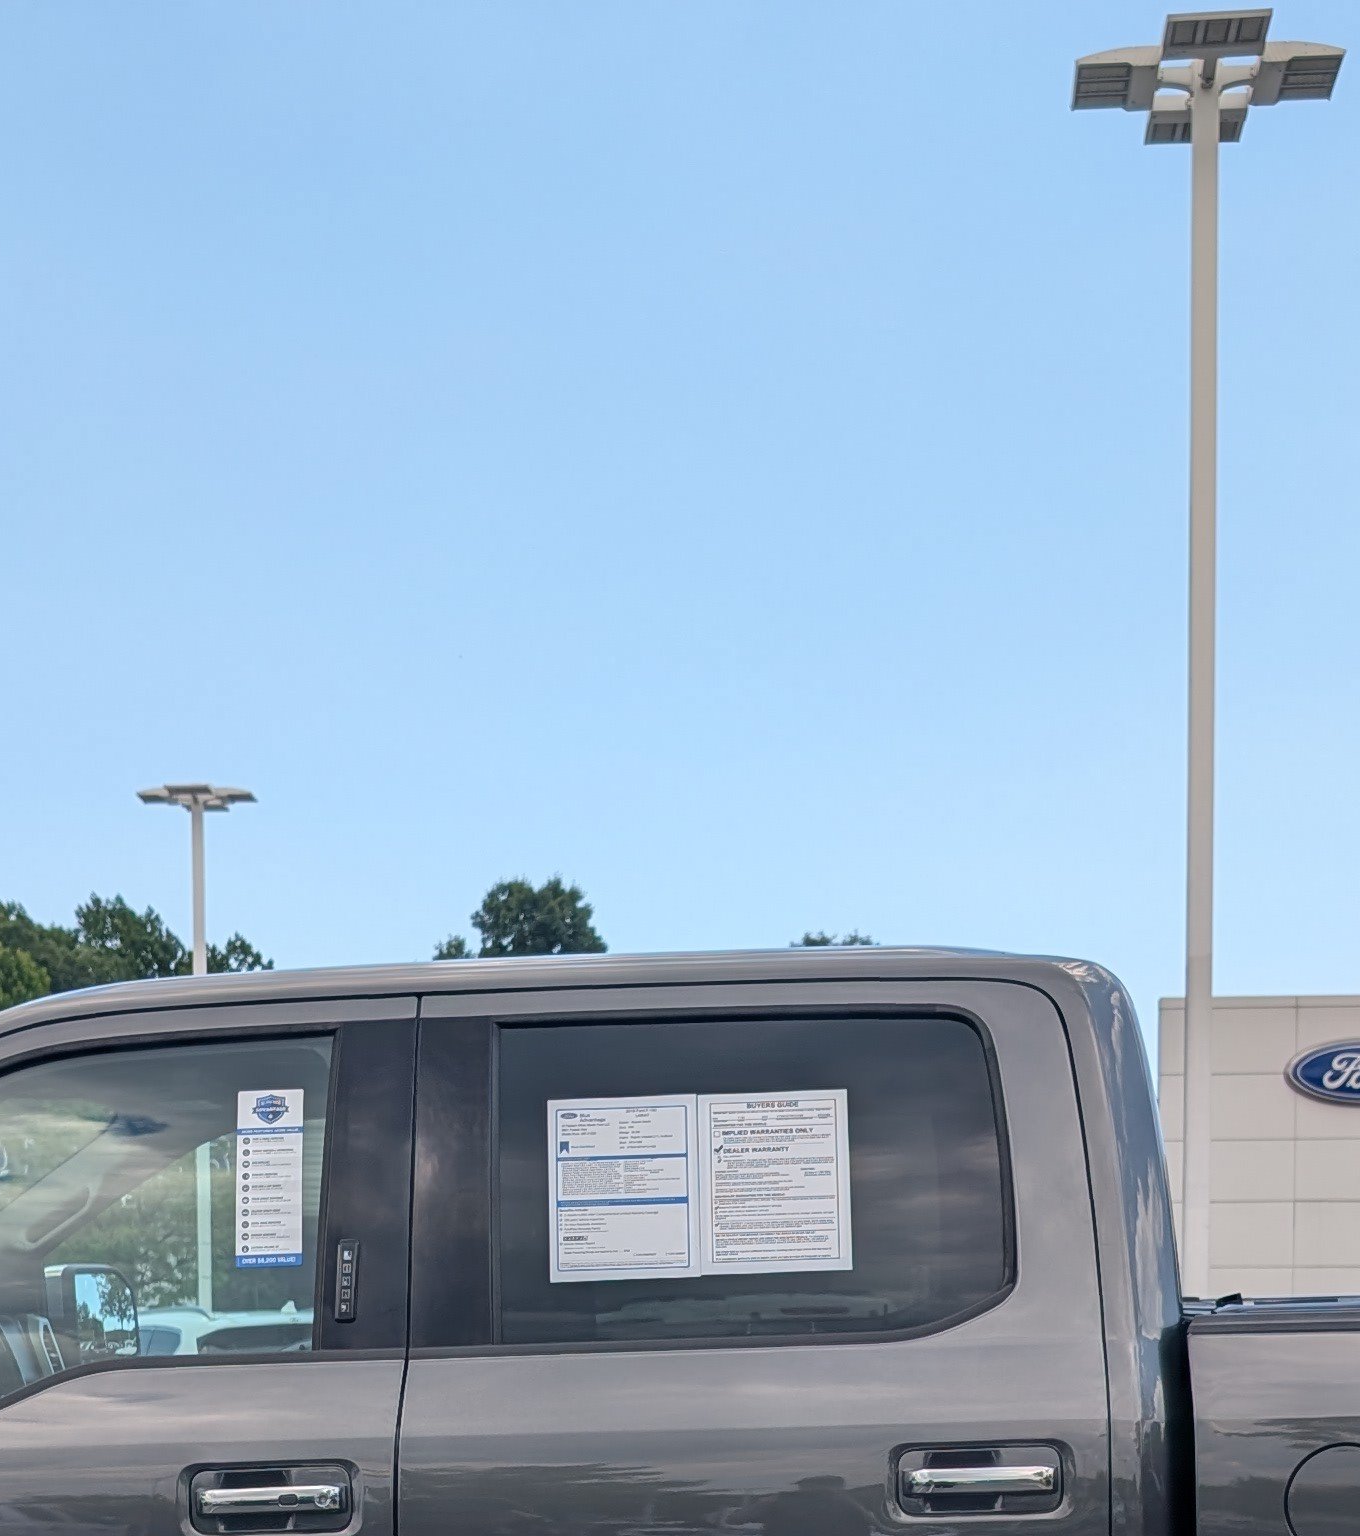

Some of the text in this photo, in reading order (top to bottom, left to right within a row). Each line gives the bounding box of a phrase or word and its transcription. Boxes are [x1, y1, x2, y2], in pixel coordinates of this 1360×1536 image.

[746, 1101, 776, 1109] BUYERS
[749, 1128, 794, 1136] WARRANTIES
[241, 1257, 256, 1265] OVER
